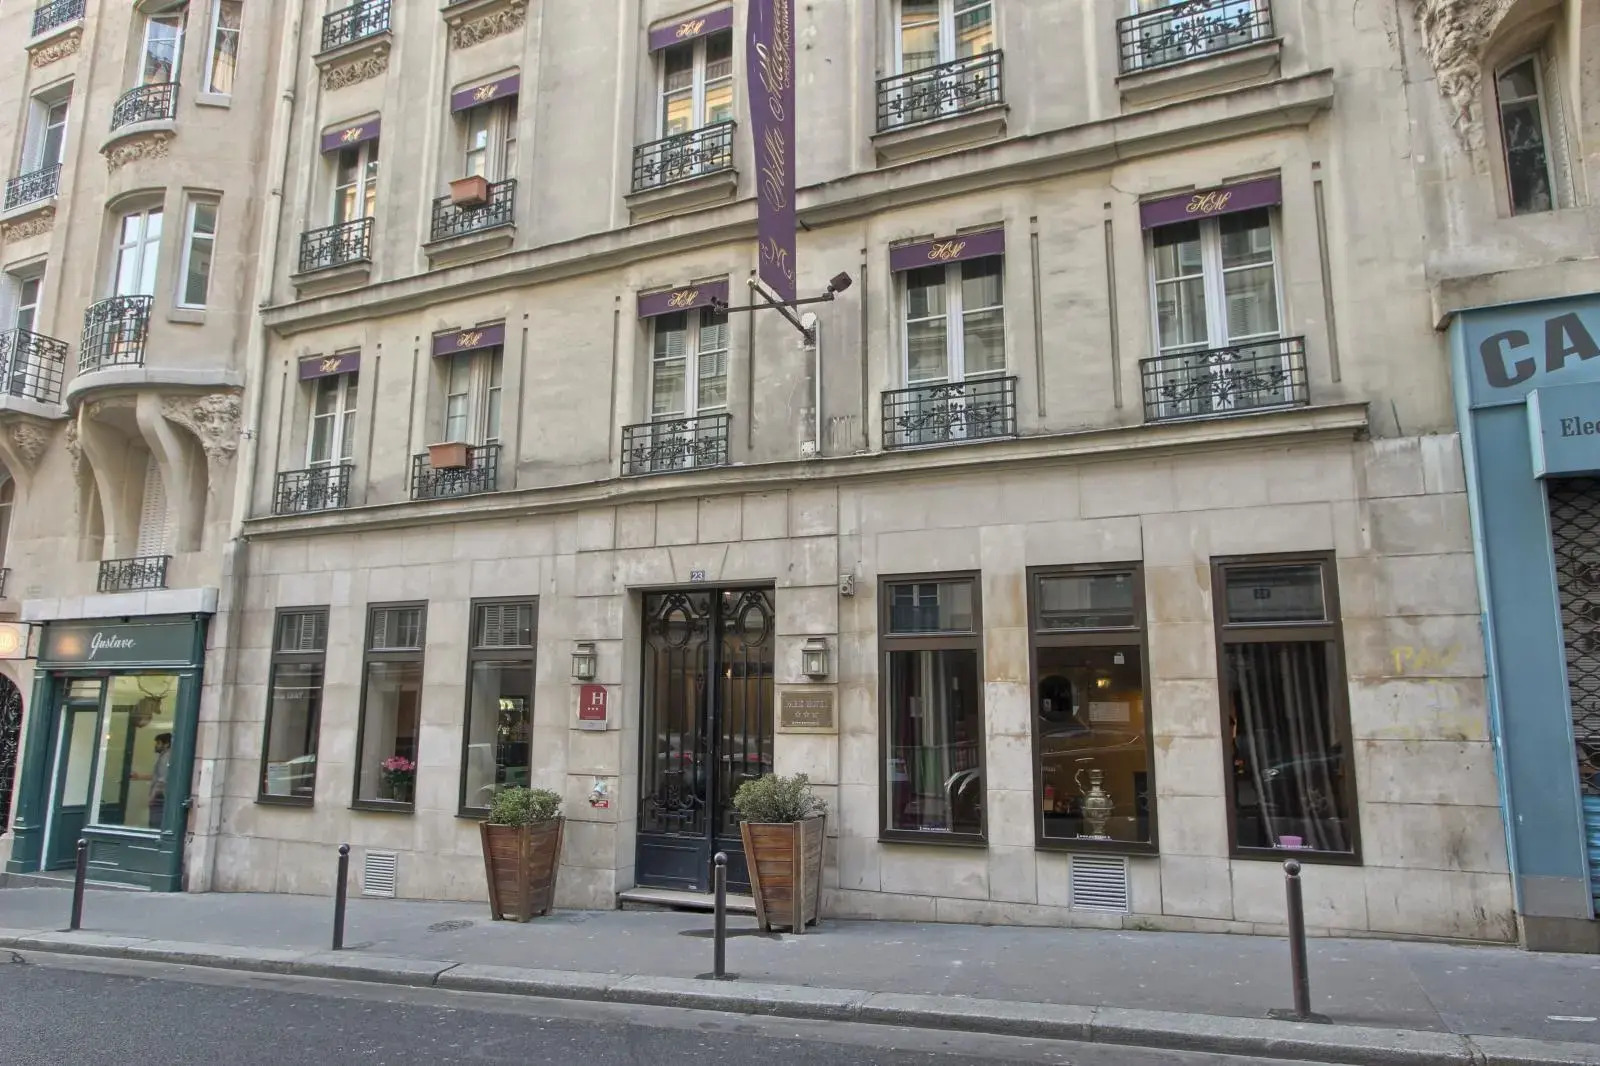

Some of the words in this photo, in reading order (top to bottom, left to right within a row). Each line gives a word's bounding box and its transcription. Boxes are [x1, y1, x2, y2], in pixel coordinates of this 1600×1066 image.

[762, 123, 787, 212] Villa
[1480, 312, 1600, 388] CA
[691, 572, 703, 581] 23
[88, 632, 136, 660] Gustave
[591, 692, 604, 705] H
